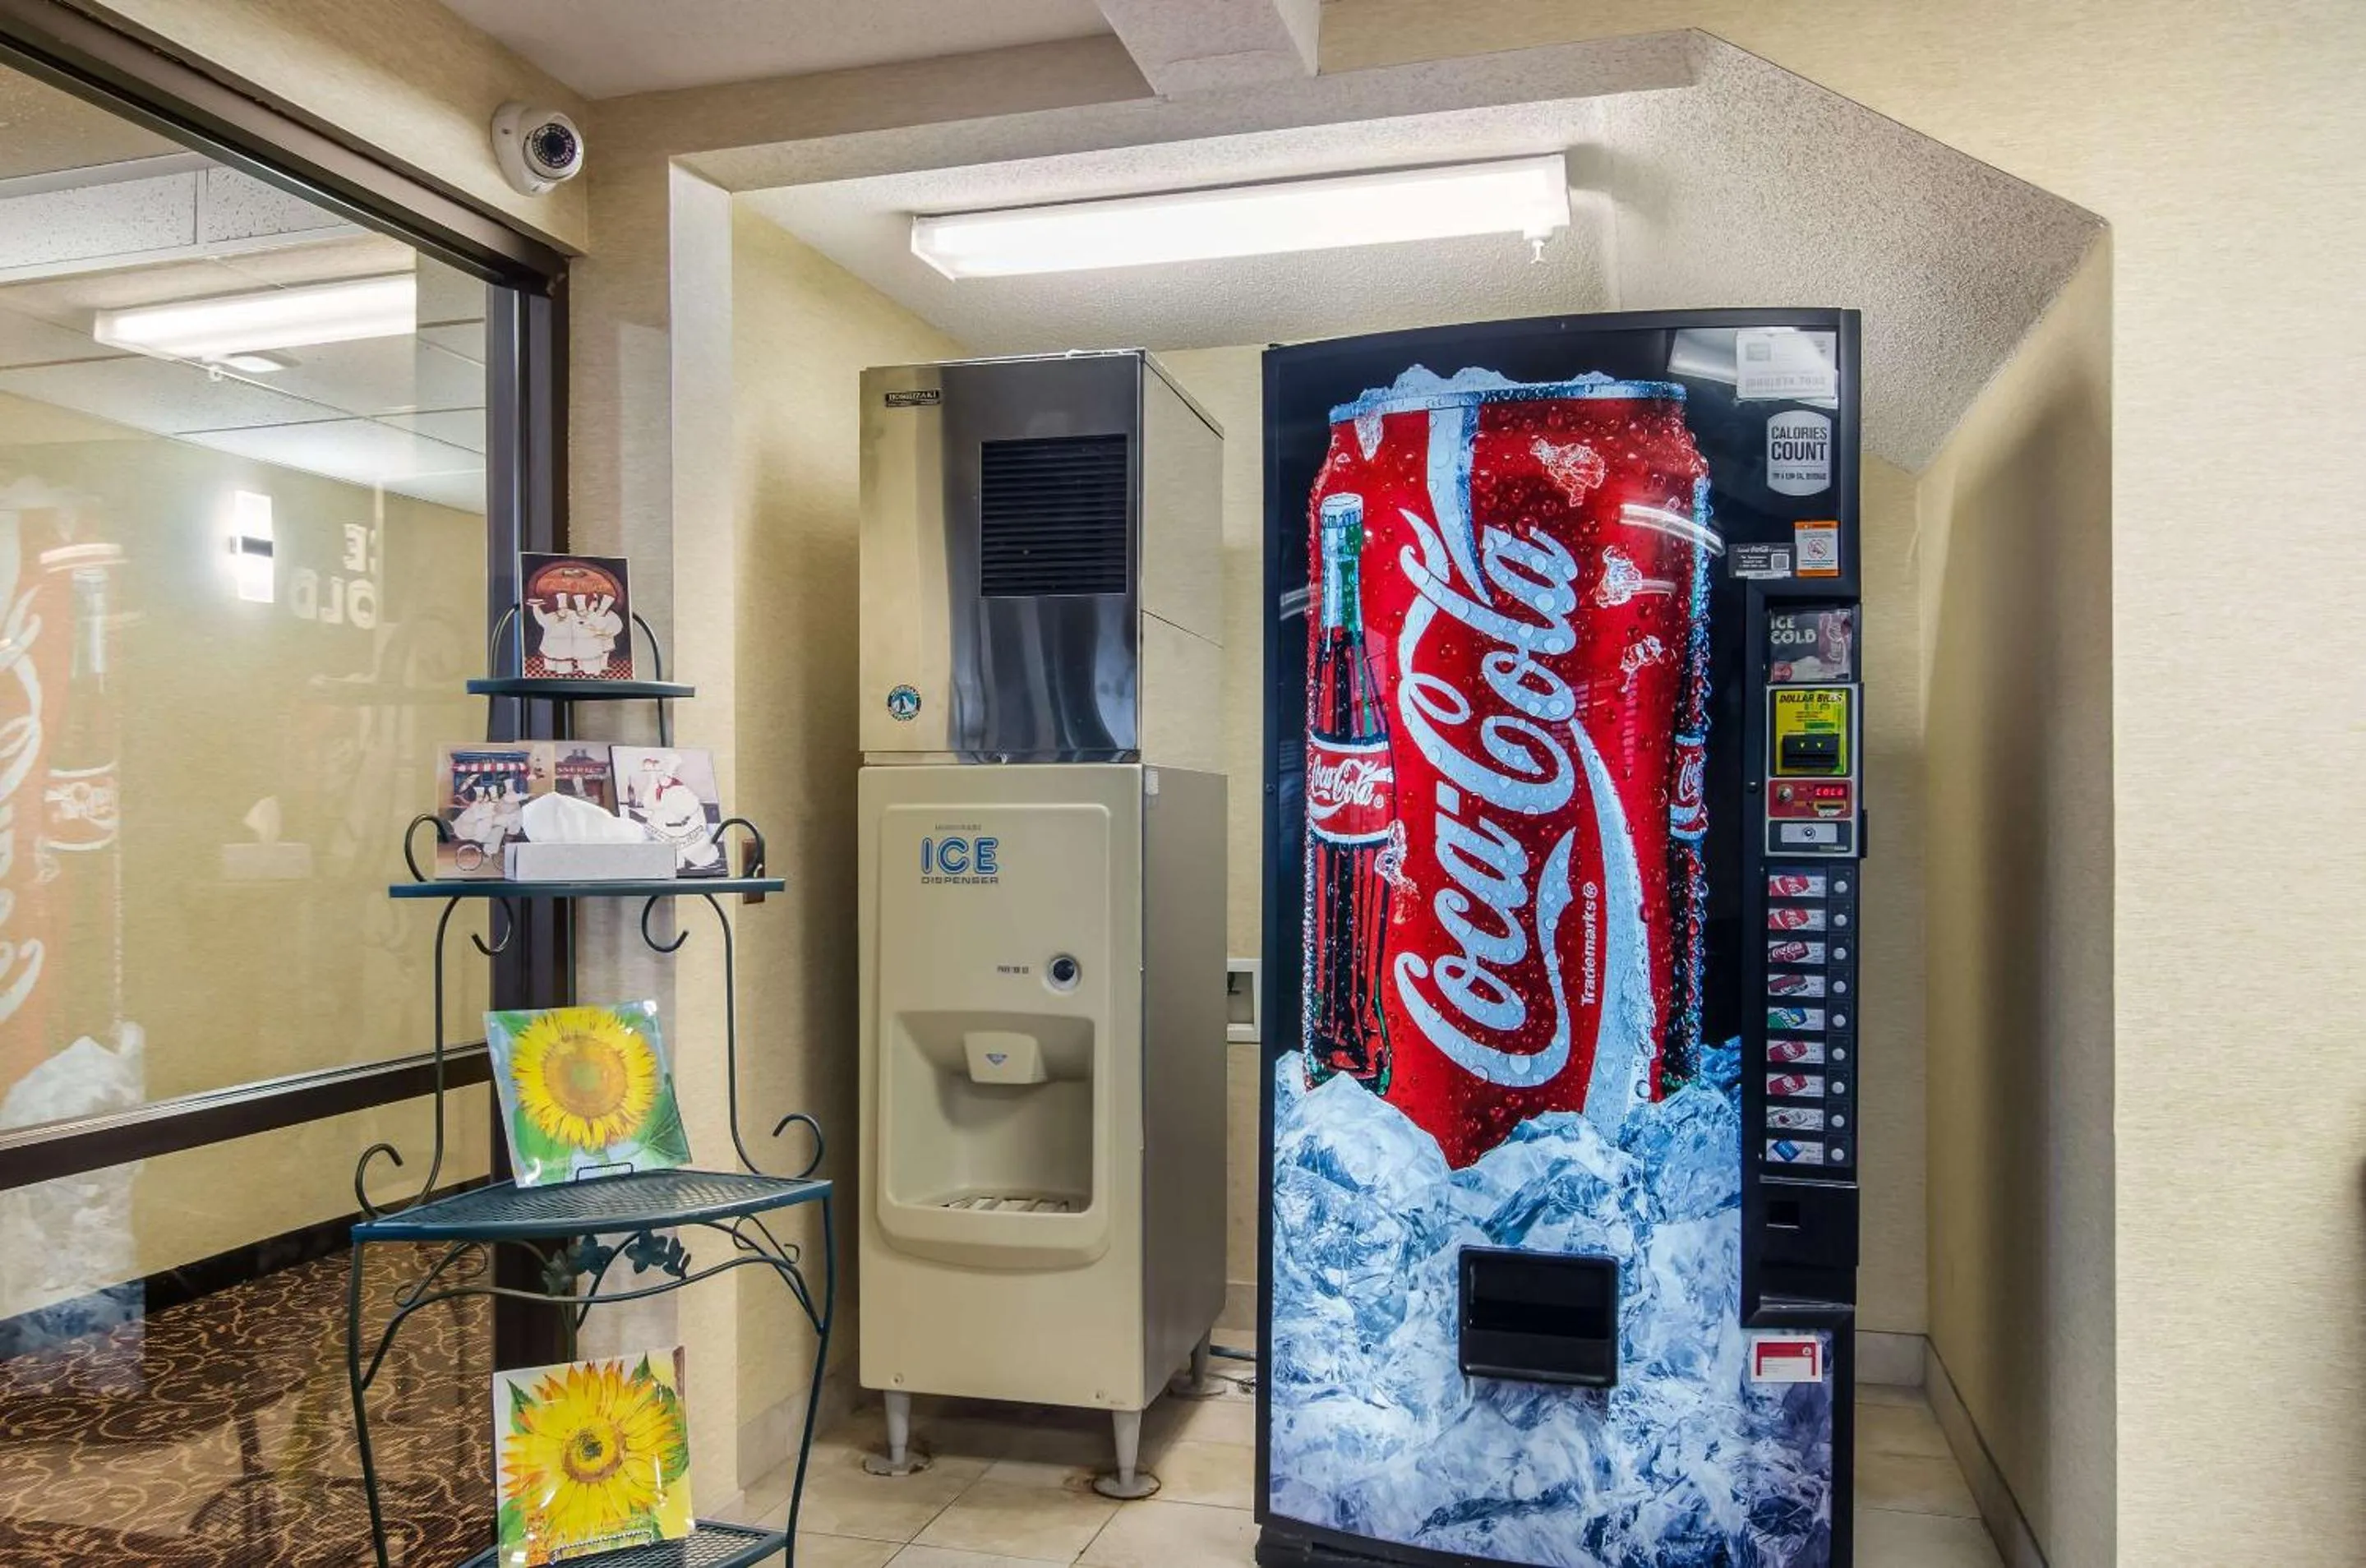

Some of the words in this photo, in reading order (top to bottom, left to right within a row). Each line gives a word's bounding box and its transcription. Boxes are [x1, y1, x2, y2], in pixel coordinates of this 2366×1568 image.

[1771, 426, 1828, 440] CALORIES
[1771, 441, 1828, 461] COUNT
[1770, 616, 1796, 630] ICE
[1770, 629, 1817, 644] COLD
[1778, 694, 1815, 703] DOLLAR
[1395, 508, 1580, 1088] Coca-Cola
[921, 837, 999, 874] ICE
[921, 876, 999, 884] DISPENSER
